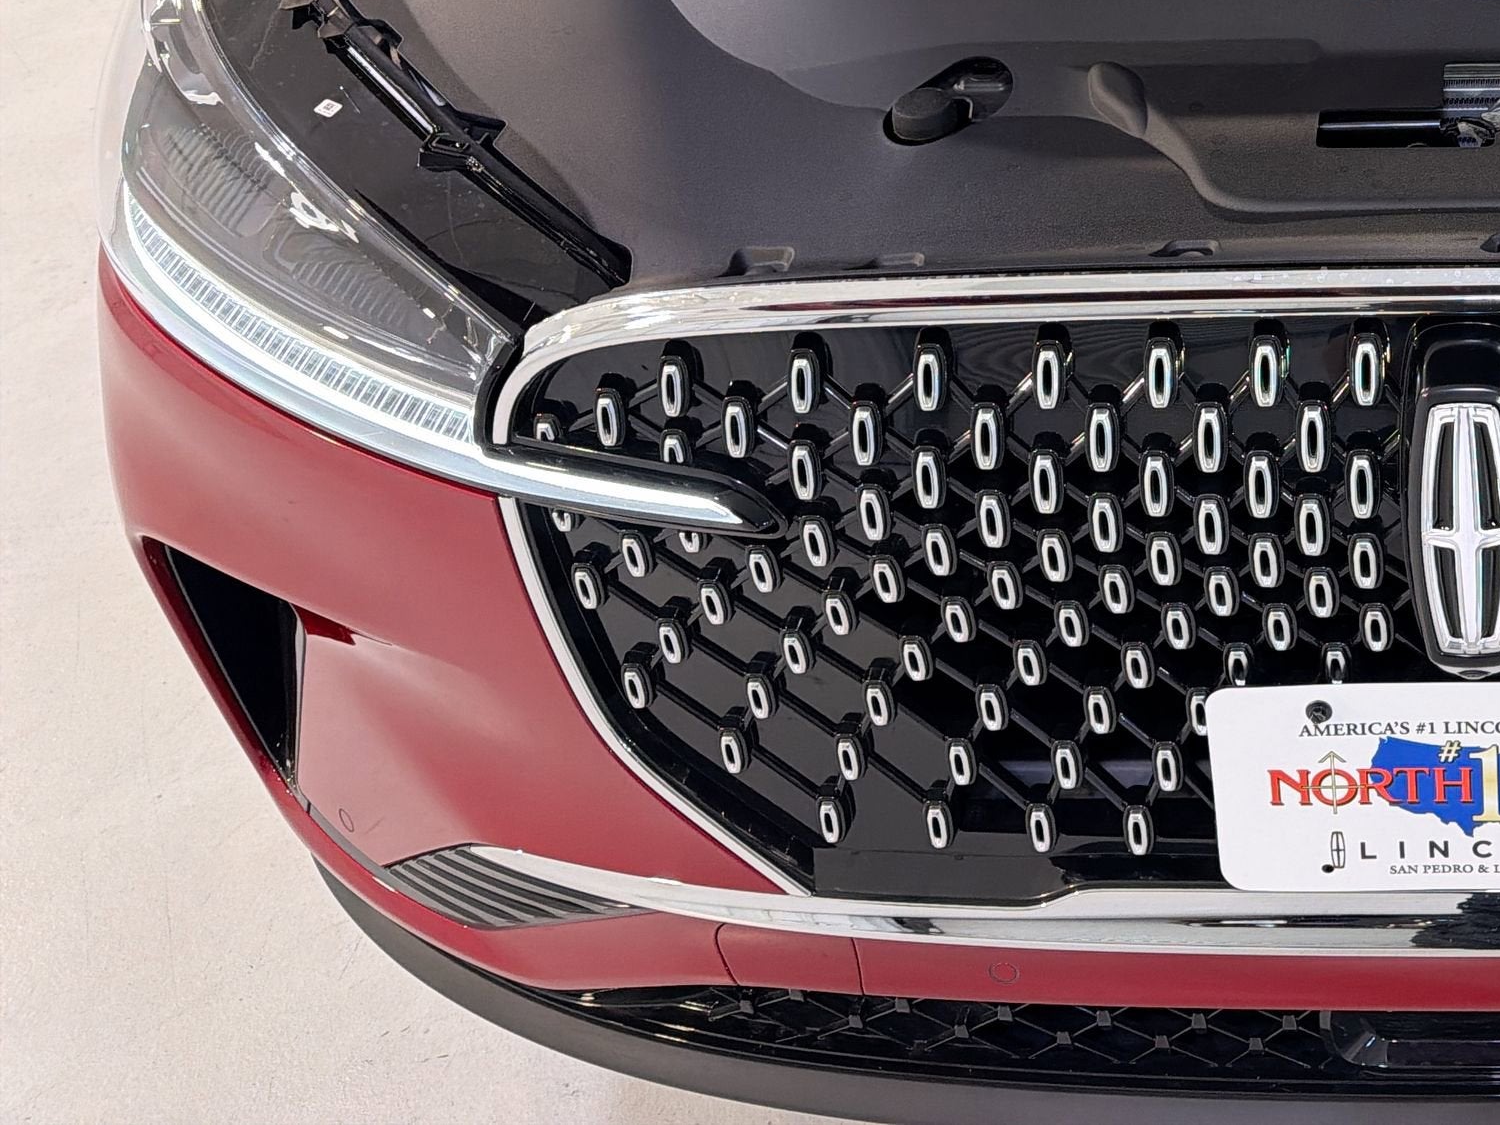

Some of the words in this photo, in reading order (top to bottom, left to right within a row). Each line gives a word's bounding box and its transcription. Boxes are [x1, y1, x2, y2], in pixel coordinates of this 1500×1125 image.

[1298, 721, 1410, 737] AMERICA'S
[1415, 721, 1437, 735] #1
[1268, 767, 1473, 806] NORTH
[1389, 864, 1418, 875] SAN
[1423, 864, 1474, 874] PEDRO
[1477, 864, 1489, 874] &
